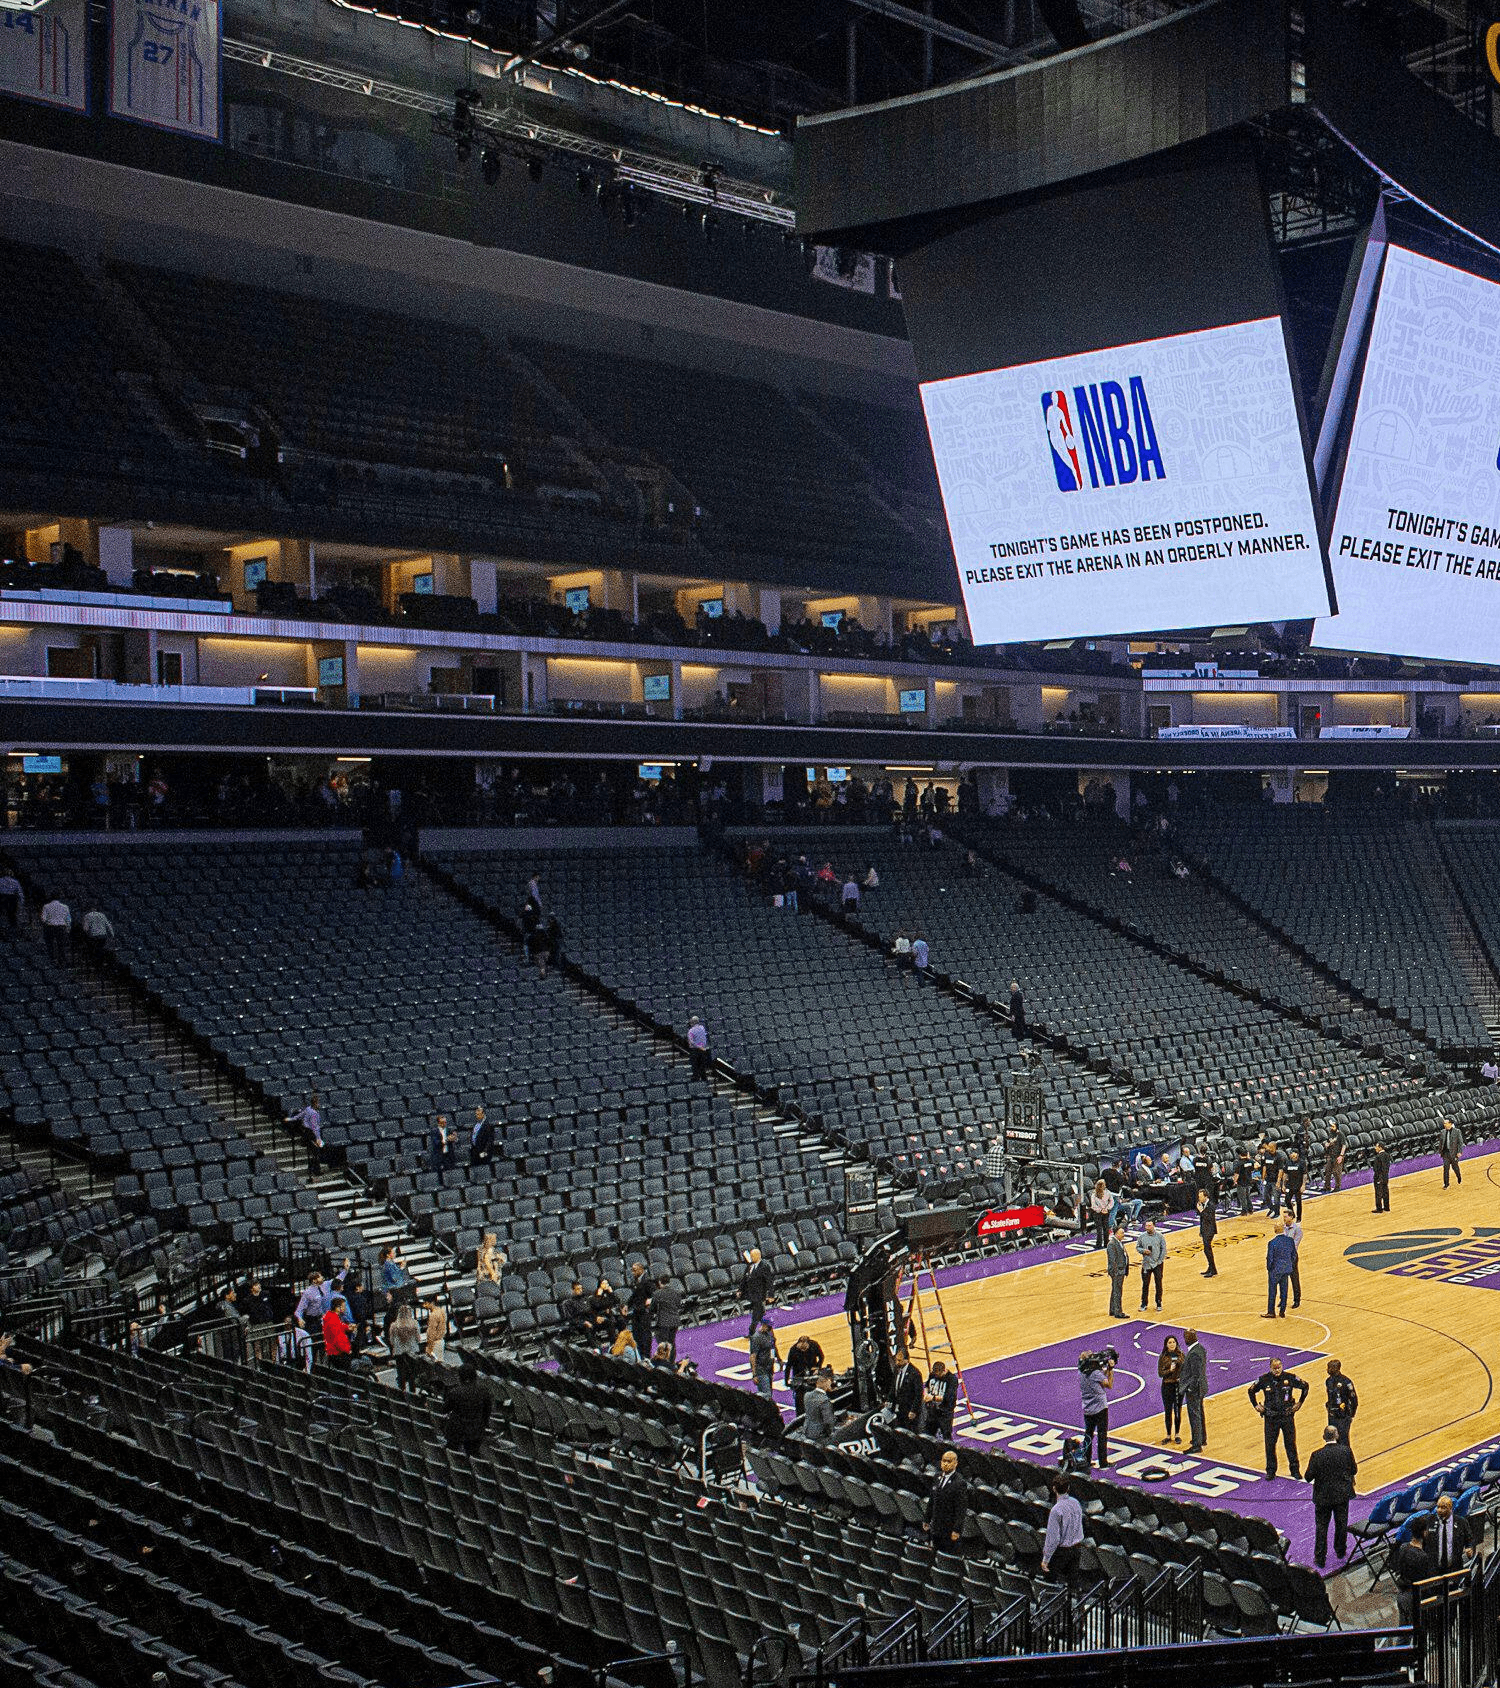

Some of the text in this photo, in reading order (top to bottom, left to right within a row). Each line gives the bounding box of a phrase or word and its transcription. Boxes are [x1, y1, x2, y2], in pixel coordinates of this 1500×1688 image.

[4, 11, 35, 35] 14
[142, 40, 175, 65] 27
[1457, 324, 1498, 357] 1985
[1072, 374, 1168, 490] NBA
[989, 512, 1269, 559] TONIGHT'S GAME HAS BEEN POSTPONED.
[1387, 508, 1469, 543] TONIGHT'S
[965, 533, 1311, 585] PLEASE EXIT THE ARENA IN AN ORDERLY MANNER.
[1338, 534, 1405, 565] PLEASE
[1406, 546, 1444, 571] EXIT
[1444, 551, 1475, 577] THE
[1013, 1130, 1038, 1140] TISSOT
[886, 1300, 897, 1333] NBA
